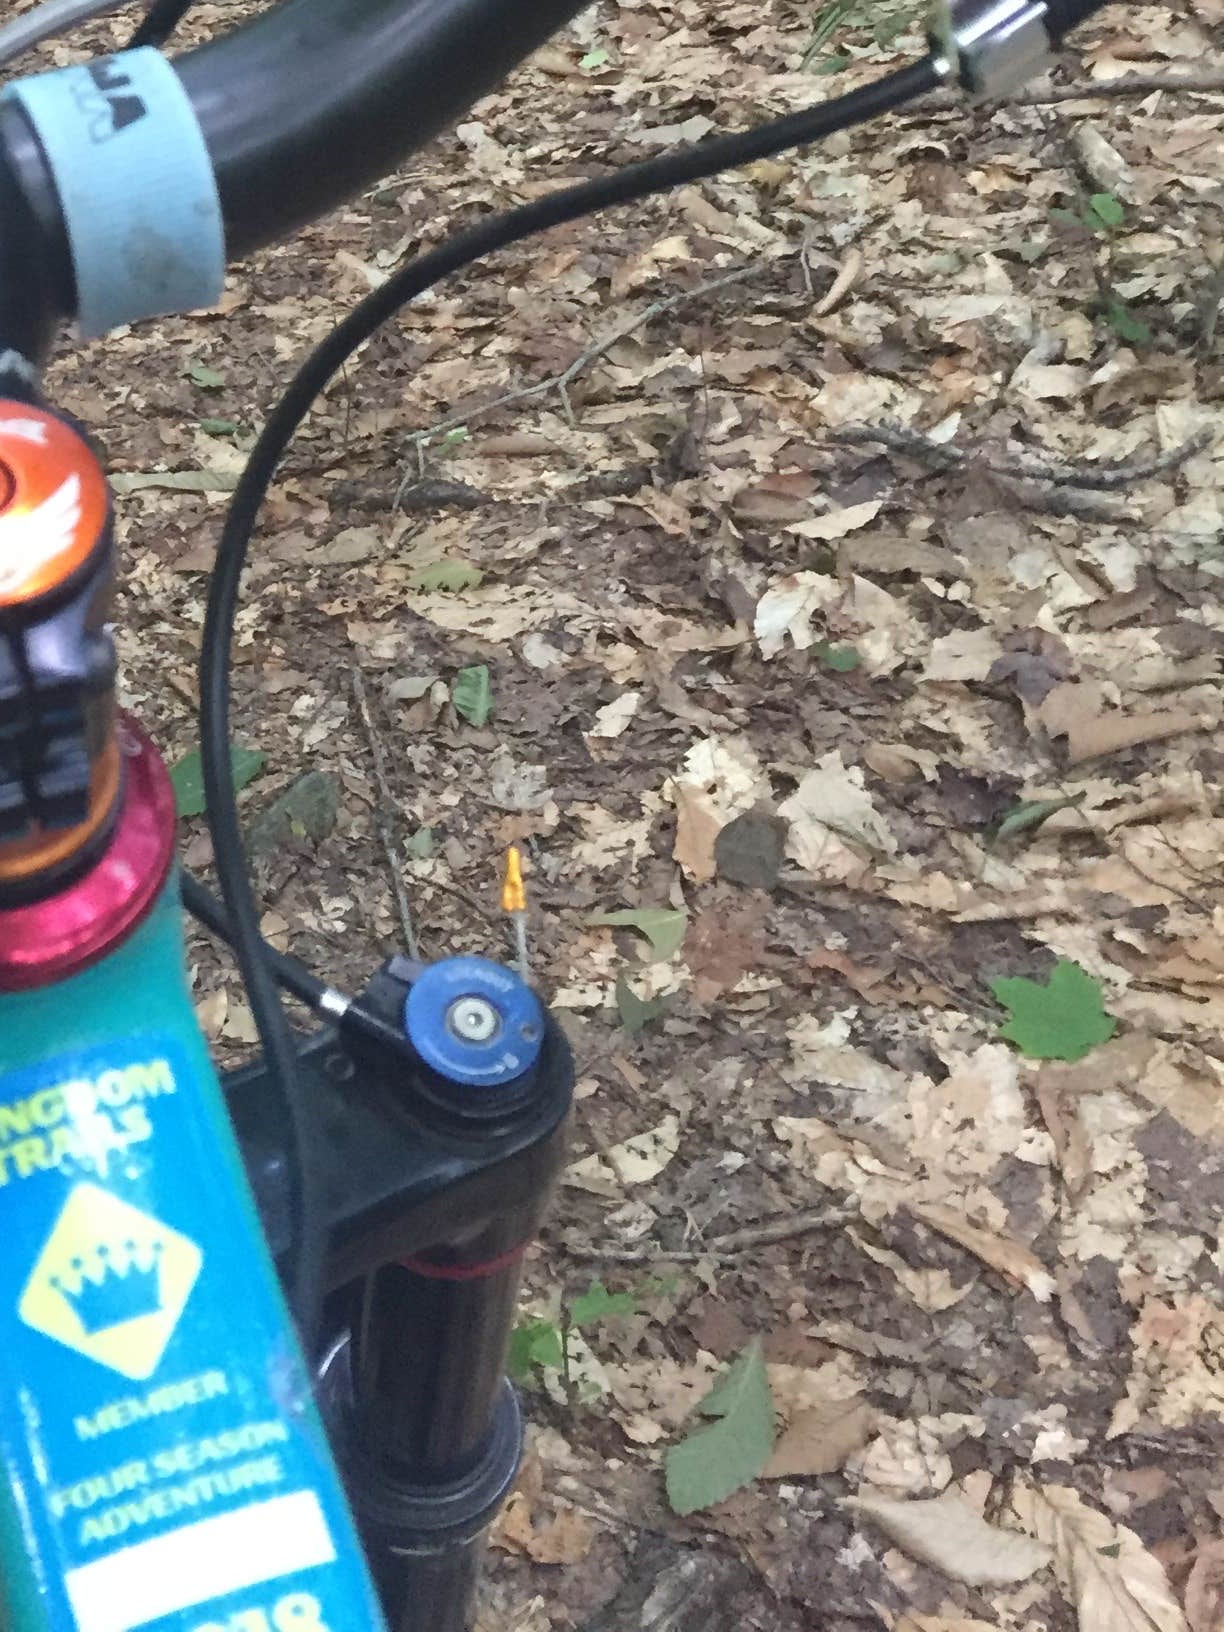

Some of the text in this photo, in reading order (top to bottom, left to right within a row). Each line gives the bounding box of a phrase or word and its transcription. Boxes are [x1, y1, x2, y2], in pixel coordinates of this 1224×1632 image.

[75, 1369, 229, 1441] MEMBER
[50, 1421, 288, 1516] FOUR SEASON
[80, 1455, 284, 1545] ADVENTURE
